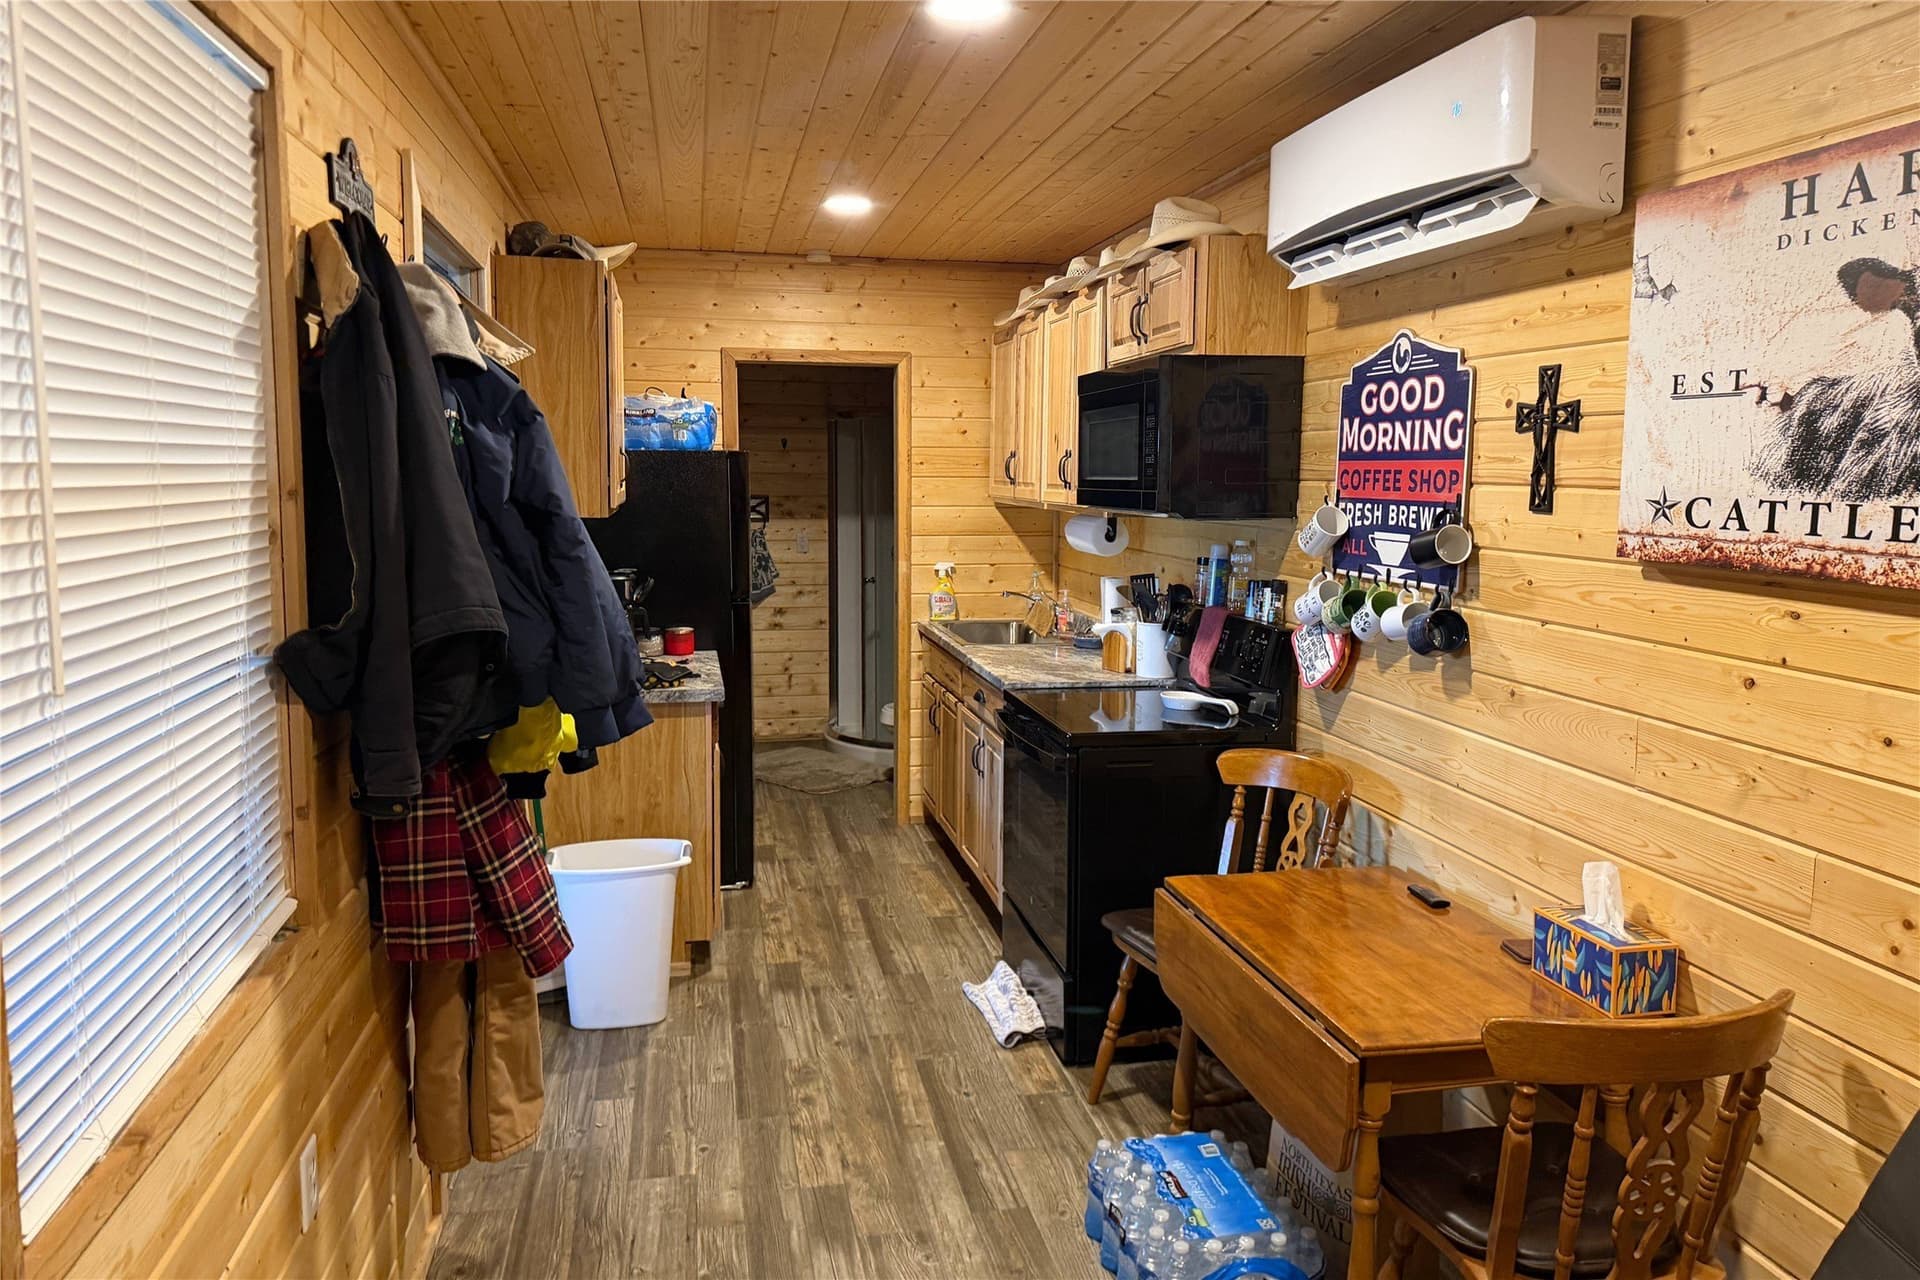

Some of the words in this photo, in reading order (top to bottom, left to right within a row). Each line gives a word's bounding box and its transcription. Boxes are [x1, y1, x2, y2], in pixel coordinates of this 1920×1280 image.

[1360, 375, 1445, 416] GOOD
[1670, 368, 1748, 395] EST
[1341, 410, 1464, 453] MORNING
[1340, 469, 1402, 492] COFFEE
[1408, 469, 1460, 493] SHOP
[1388, 504, 1454, 531] BREW
[1685, 496, 1920, 544] CATTLE
[1342, 538, 1367, 556] ALL
[1278, 1151, 1313, 1199] IRISH
[1281, 1136, 1313, 1175] NORTH
[1314, 1165, 1352, 1201] TEXAS
[1275, 1172, 1352, 1245] FESTIVAL
